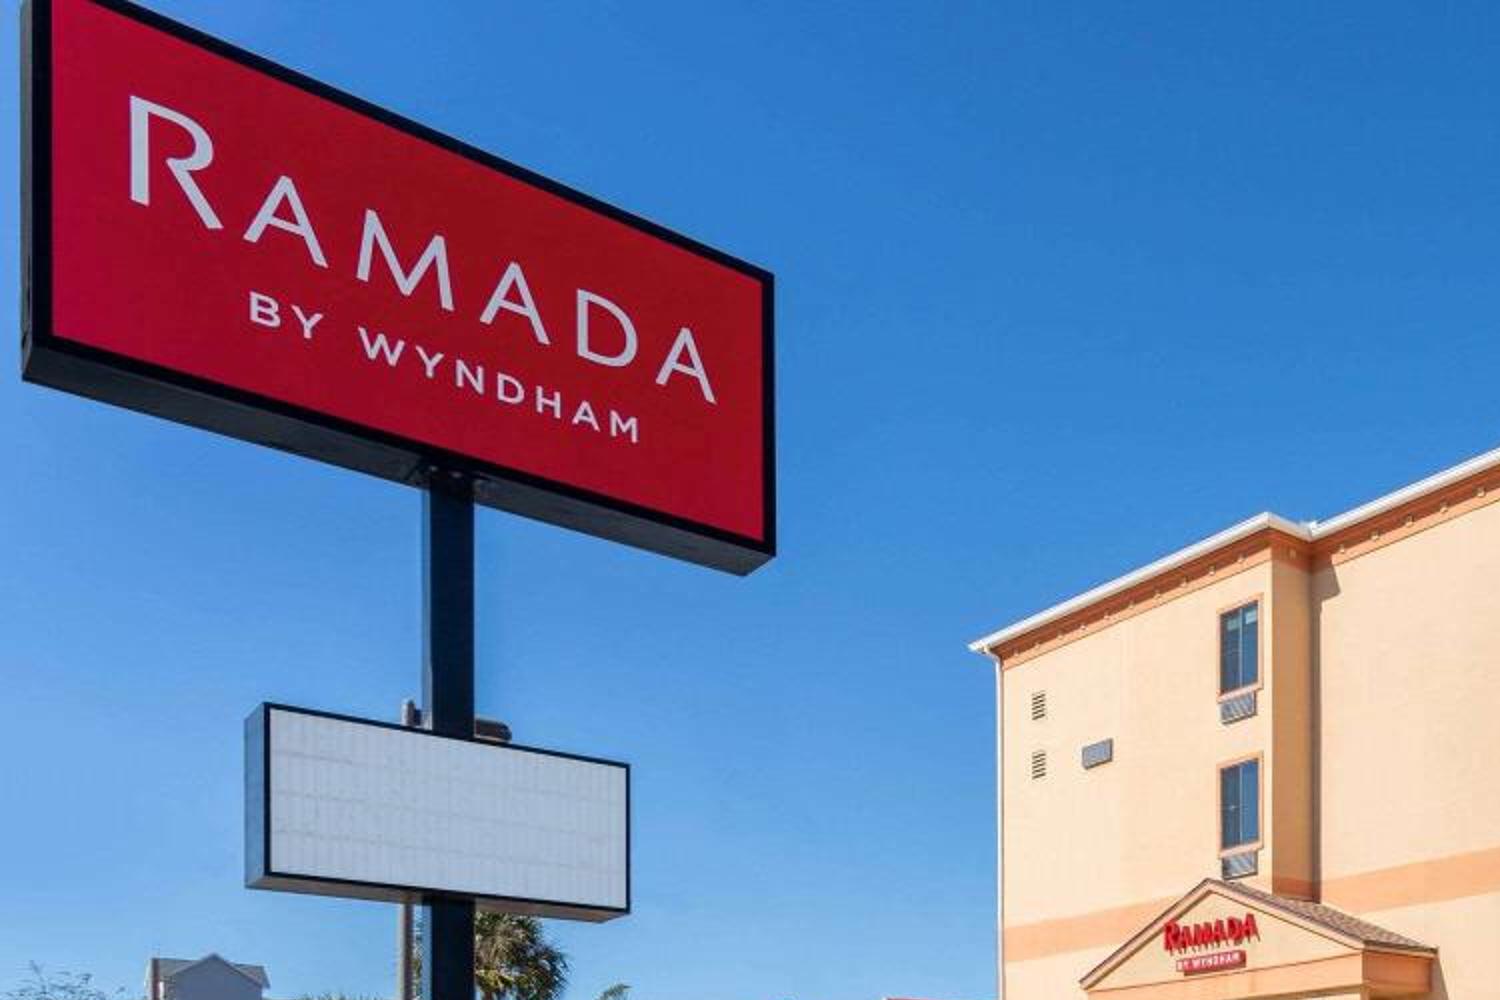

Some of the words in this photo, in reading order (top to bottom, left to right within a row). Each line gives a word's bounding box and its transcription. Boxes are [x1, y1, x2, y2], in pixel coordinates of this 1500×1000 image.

[130, 95, 716, 404] RAMADA
[249, 291, 324, 340] BY
[358, 326, 639, 444] WYNDHAM
[1164, 912, 1260, 951] RAMADA
